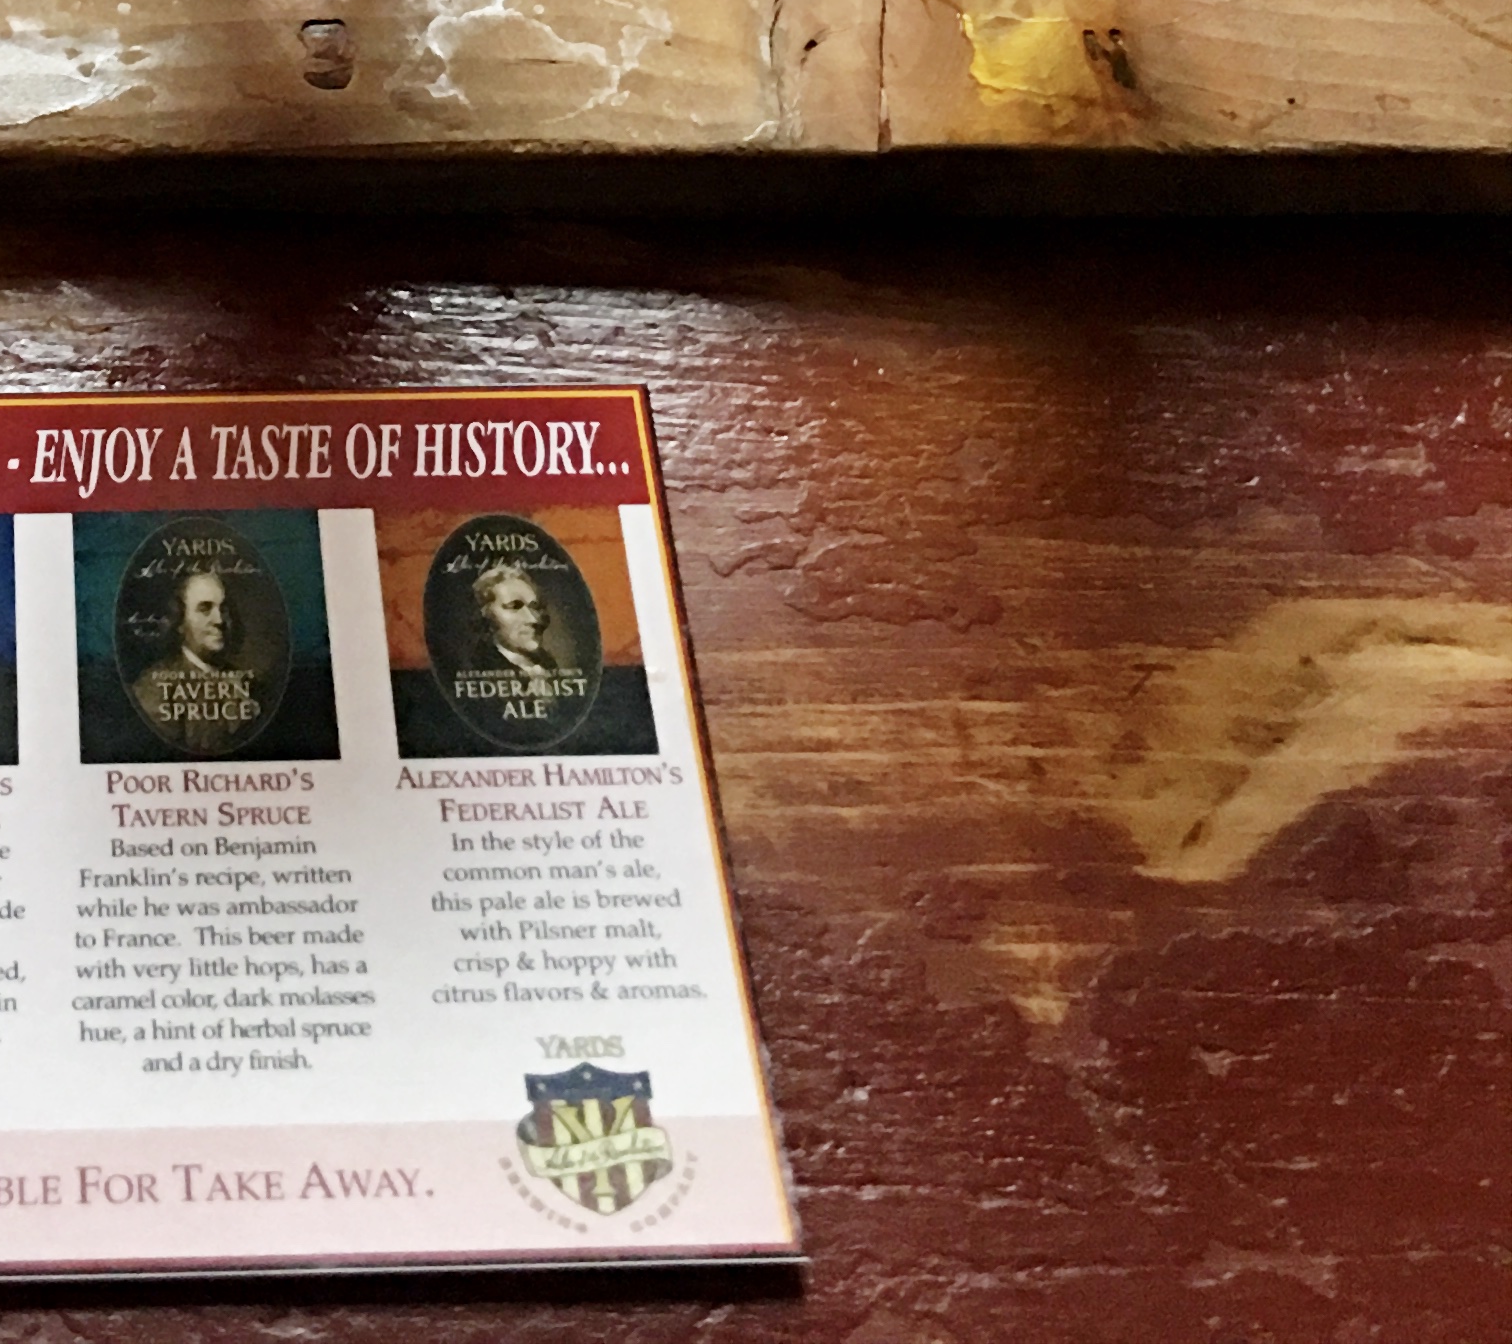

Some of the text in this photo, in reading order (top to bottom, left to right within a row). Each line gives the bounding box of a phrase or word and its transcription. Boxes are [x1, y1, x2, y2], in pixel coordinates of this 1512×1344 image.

[30, 428, 163, 498] ENJOY
[169, 425, 196, 481] A
[210, 424, 332, 480] TASTE
[345, 422, 403, 479] OF
[162, 537, 236, 556] YARDS
[465, 532, 539, 551] YARDS
[157, 682, 250, 700] TAVERN
[454, 679, 587, 698] FEDERALIST
[158, 701, 252, 721] SPRUCE
[503, 699, 548, 719] ALE
[106, 768, 314, 794] POOR RICHARD'S
[396, 762, 683, 789] ALEXANDER HAMILTON'S
[112, 802, 311, 828] TAVERN SPRUCE
[439, 796, 649, 823] FEDERALIST ALE
[111, 835, 317, 860] Based on Benjamin
[452, 829, 644, 855] In the style of the
[79, 867, 352, 891] Franklin's recipe, written
[443, 860, 660, 882] common man's ale,
[77, 894, 358, 917] while he was ambassador
[431, 889, 681, 916] this pale ale is brewed
[75, 924, 364, 948] to France. This beer made
[460, 918, 661, 941] with Pilsner malt,
[77, 954, 367, 983] with very little hops, has a
[535, 1034, 625, 1059] YARDS
[76, 1166, 160, 1206] FOR
[172, 1163, 284, 1203] TAKE
[299, 1162, 435, 1200] AWAY.
